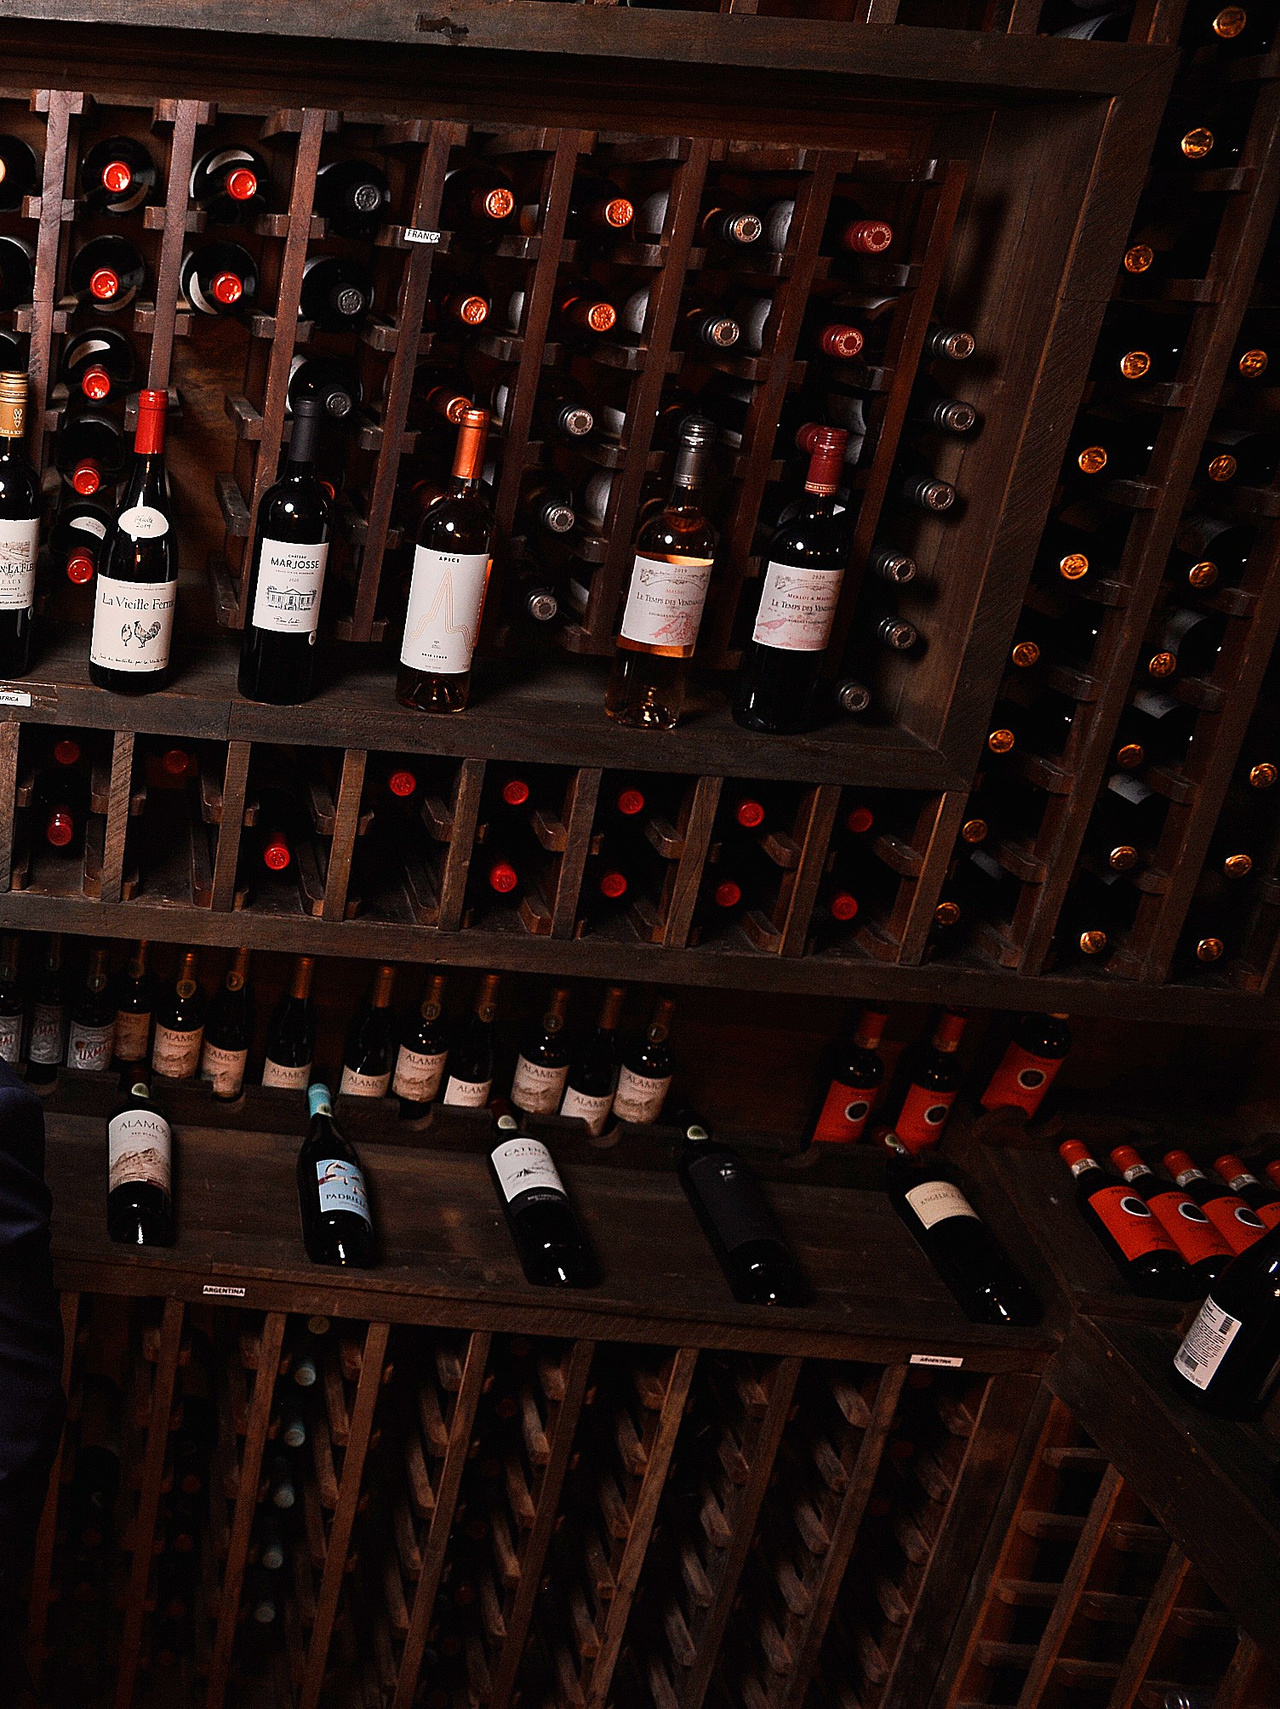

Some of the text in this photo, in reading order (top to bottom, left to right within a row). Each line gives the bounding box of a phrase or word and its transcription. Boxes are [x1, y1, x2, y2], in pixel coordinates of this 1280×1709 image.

[407, 229, 441, 242] FRANÇA
[270, 556, 320, 570] MARJOSSE
[438, 555, 461, 564] APICE
[102, 591, 114, 606] La
[115, 594, 150, 611] Vieille
[203, 1286, 244, 1295] ARGENTINA
